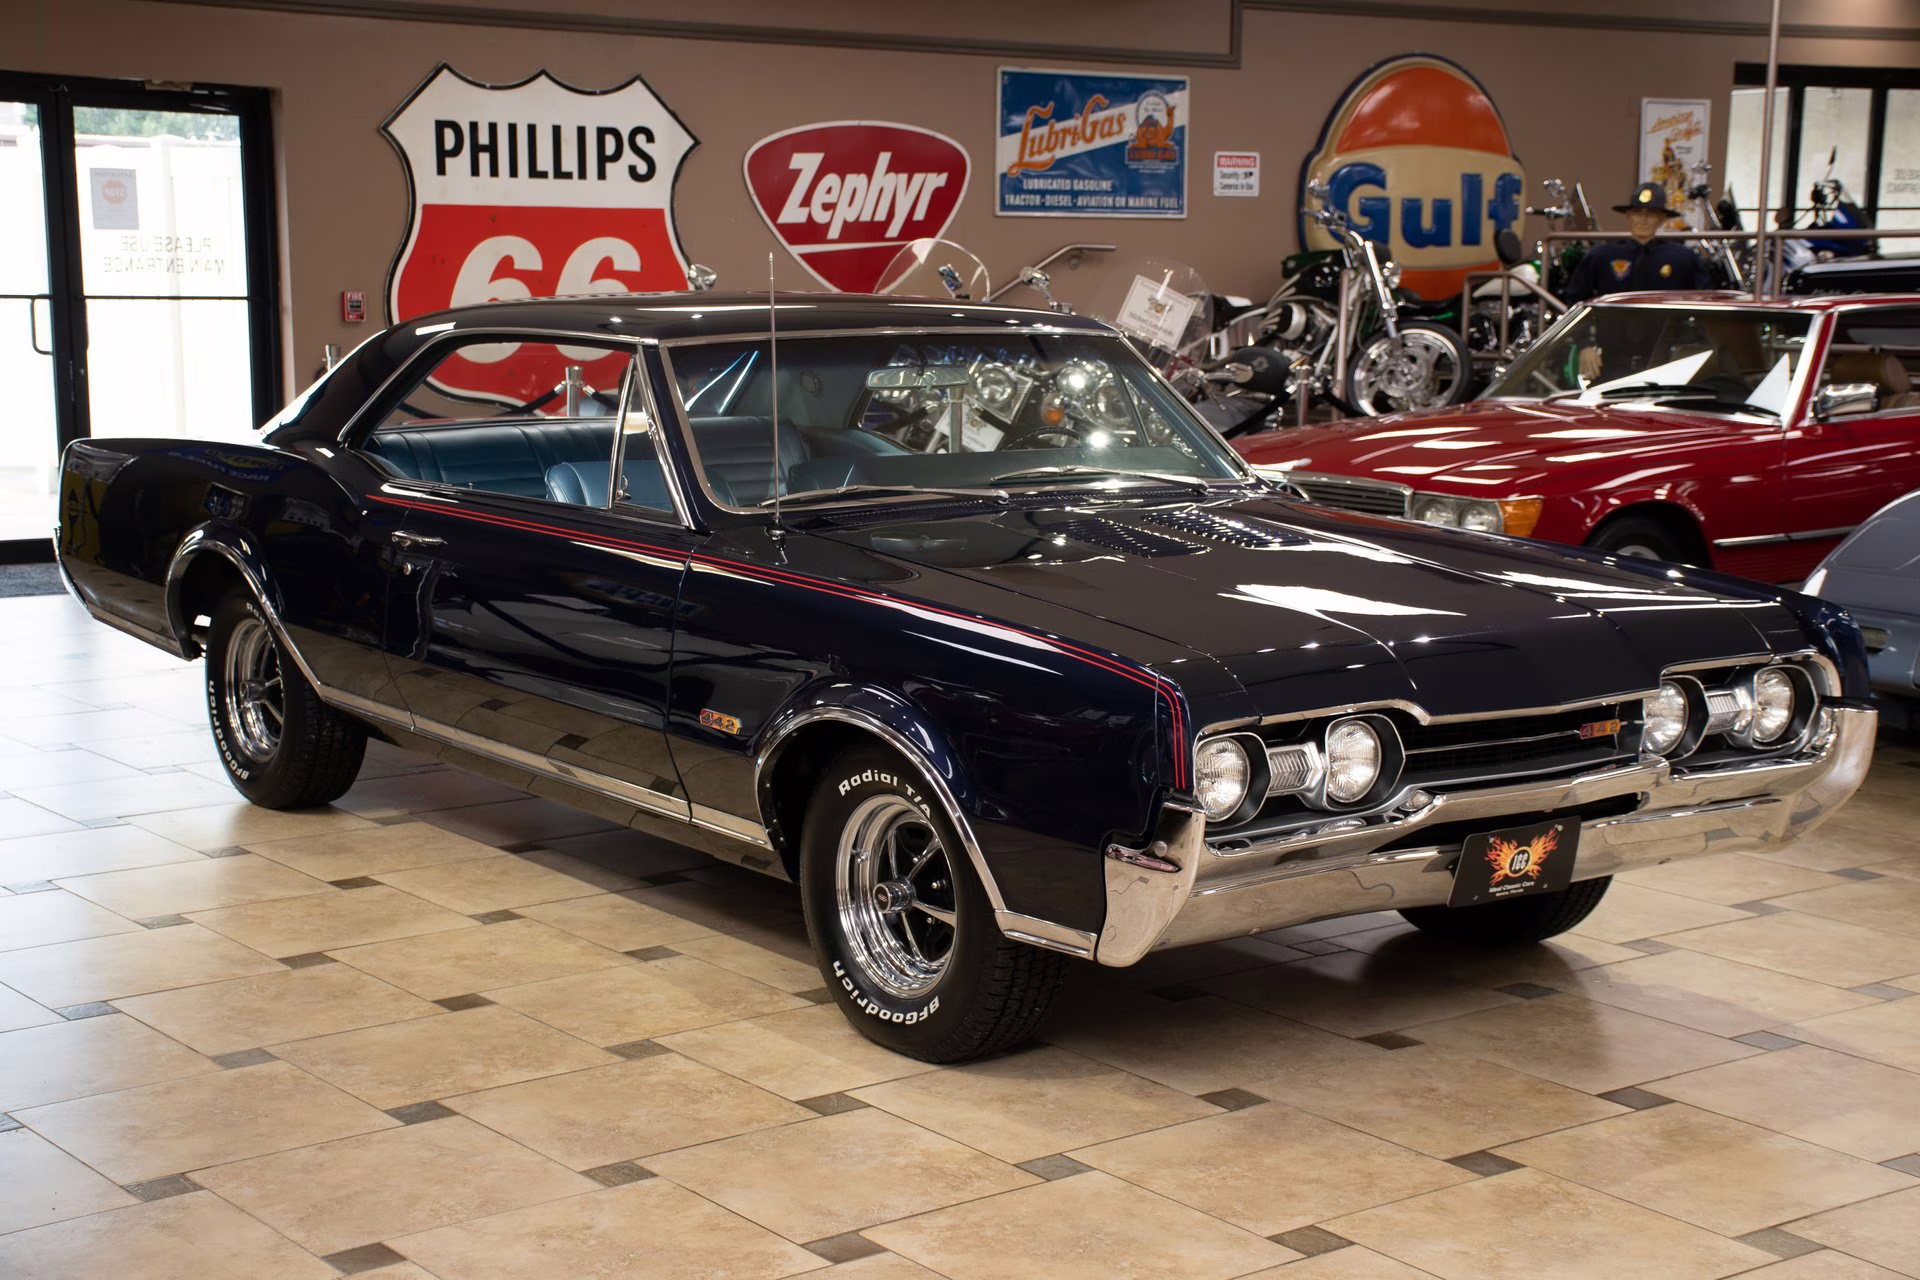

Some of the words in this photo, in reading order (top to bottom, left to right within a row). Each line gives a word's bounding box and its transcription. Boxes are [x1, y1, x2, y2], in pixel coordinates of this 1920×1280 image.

[434, 119, 657, 183] PHILLIPS
[1219, 157, 1255, 167] WARNING
[776, 151, 949, 240] Zephyr
[1023, 178, 1072, 190] LUBRICATED
[1073, 179, 1112, 191] GASOLINE
[1128, 196, 1158, 208] MARINE
[1327, 162, 1522, 249] Gulf
[450, 235, 641, 363] 66
[209, 680, 250, 780] BFGoodrich
[702, 711, 737, 732] 442
[1582, 721, 1618, 738] 442
[838, 769, 898, 796] Radial
[905, 784, 932, 820] T/A
[833, 959, 940, 1025] BFGoodrich
